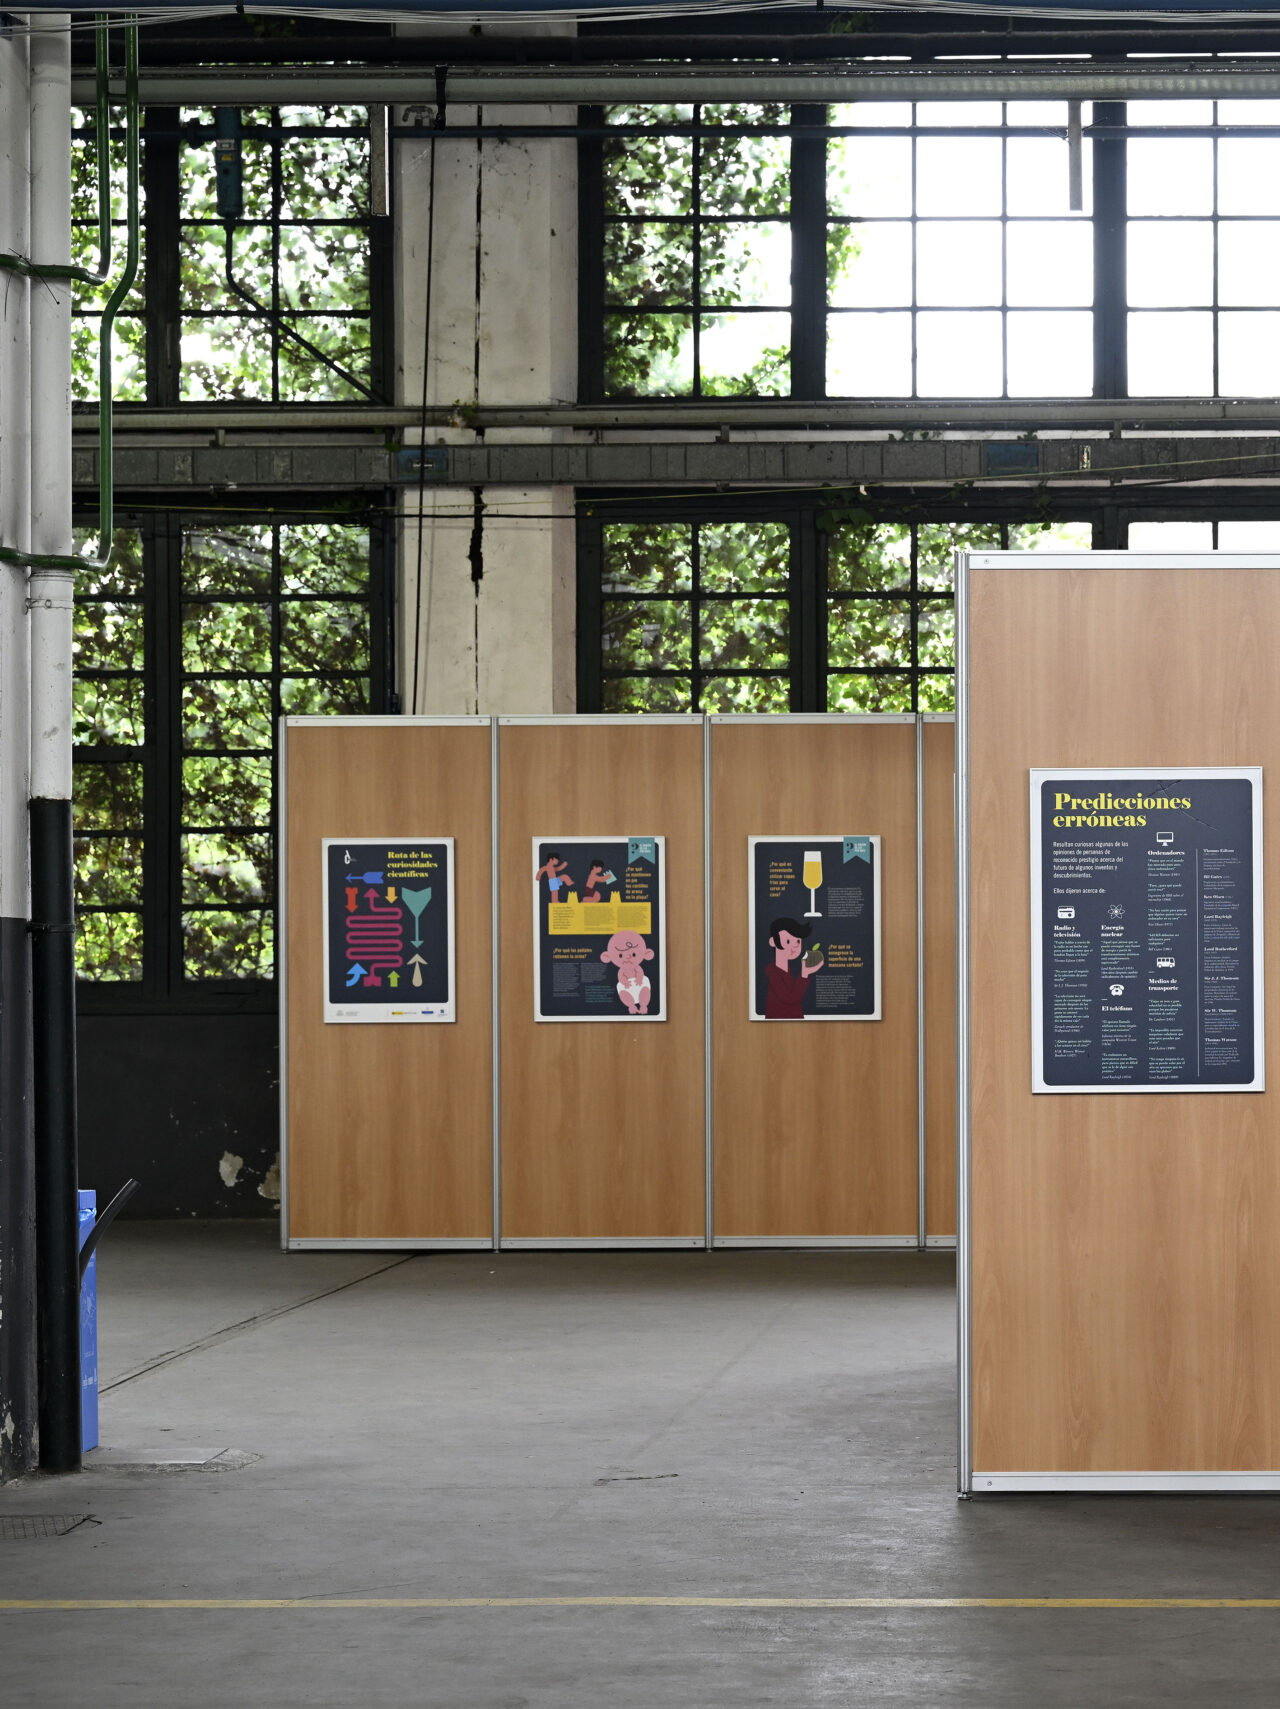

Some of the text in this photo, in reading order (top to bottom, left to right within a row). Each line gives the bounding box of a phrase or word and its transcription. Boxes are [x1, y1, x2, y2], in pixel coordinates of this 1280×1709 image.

[1054, 793, 1192, 810] Predicciones
[1053, 811, 1147, 827] erróneas
[1095, 841, 1114, 849] algunas
[387, 851, 433, 859] Ruta de las
[1053, 849, 1075, 857] opiniones
[1078, 857, 1099, 865] prestigio
[1075, 865, 1093, 873] algunos
[387, 870, 429, 878] científicas
[1065, 888, 1082, 896] dijeron
